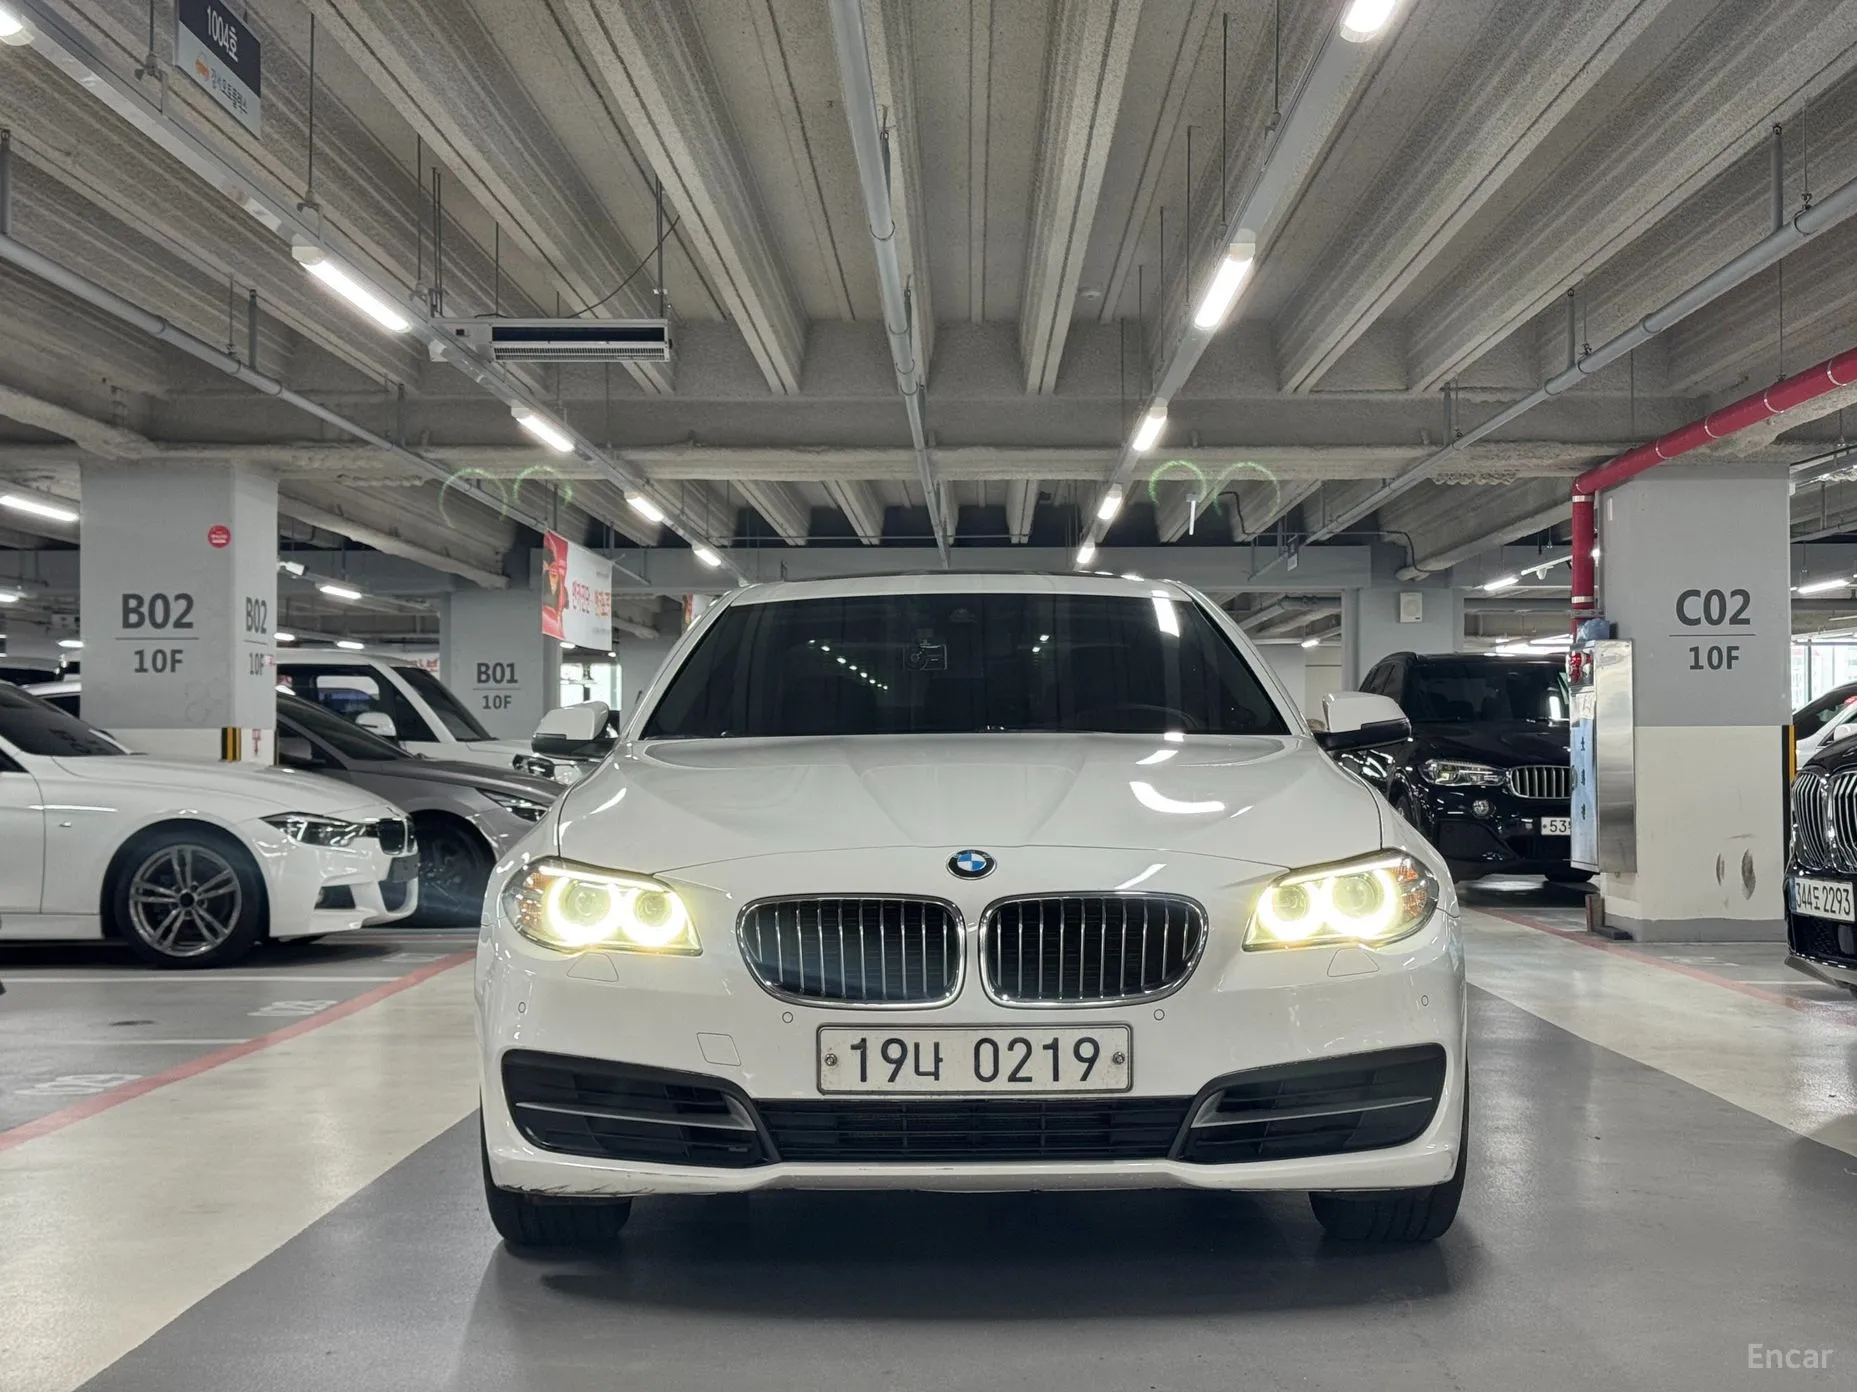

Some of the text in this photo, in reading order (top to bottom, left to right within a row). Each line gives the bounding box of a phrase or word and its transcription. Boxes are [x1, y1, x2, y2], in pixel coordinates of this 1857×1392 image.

[207, 5, 239, 62] 1004호
[121, 593, 194, 630] B02
[245, 596, 268, 634] B02
[1675, 588, 1751, 626] C02
[133, 649, 184, 673] 10F
[249, 652, 265, 676] 10F
[476, 661, 519, 684] B01
[1688, 645, 1740, 671] 10F
[482, 694, 512, 710] 10F
[1822, 885, 1851, 916] 2293
[850, 1036, 1101, 1083] 19나 0219
